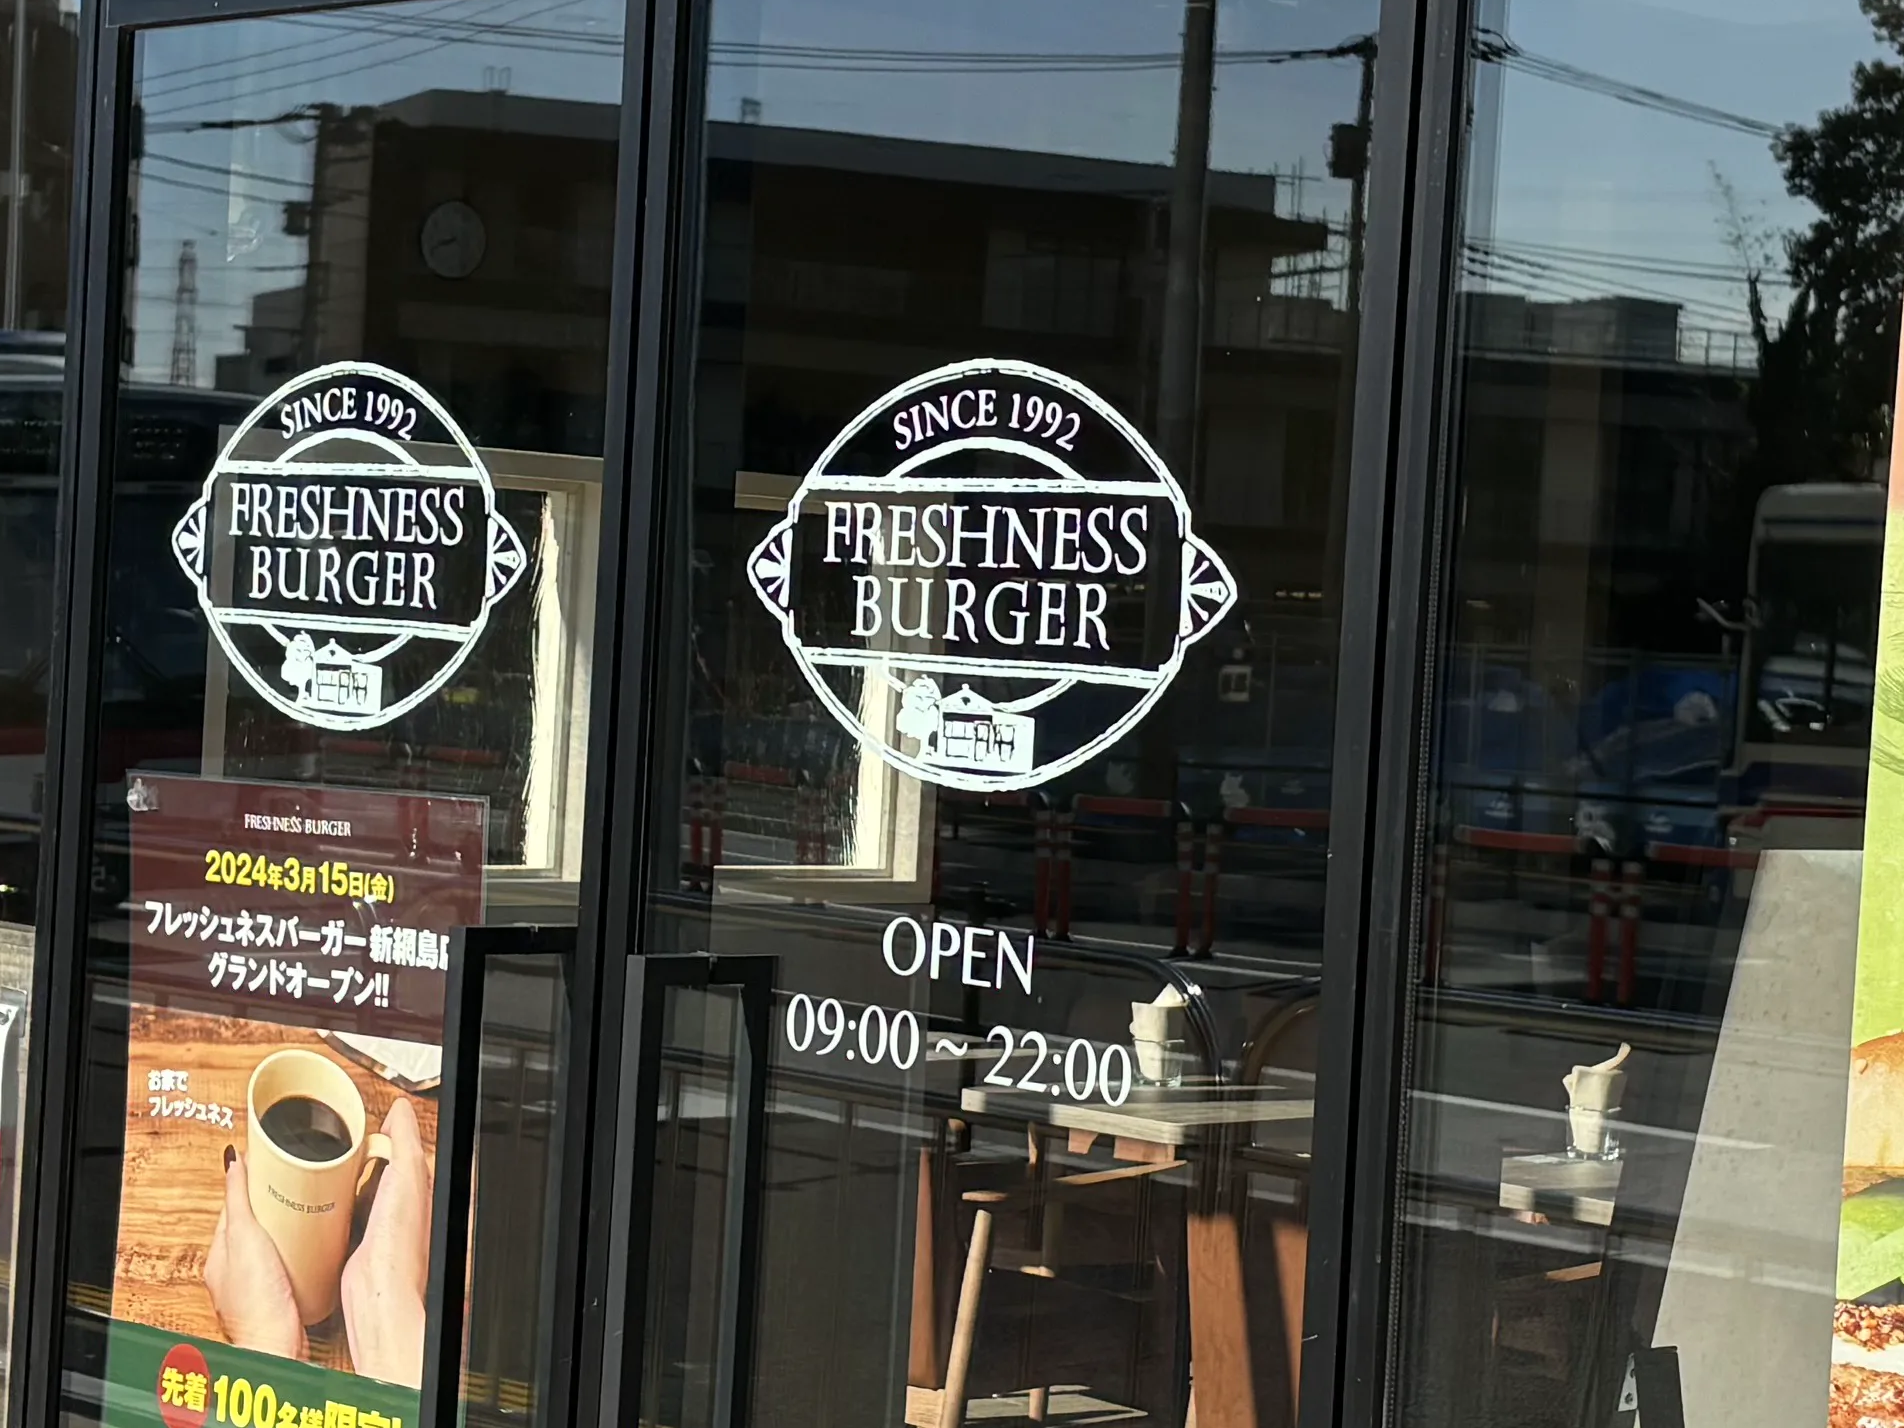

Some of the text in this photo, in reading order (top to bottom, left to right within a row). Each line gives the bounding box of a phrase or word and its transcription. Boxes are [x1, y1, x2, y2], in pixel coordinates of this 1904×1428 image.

[281, 387, 418, 441] SINCE 1992
[893, 389, 1082, 452] SINCE 1992
[228, 482, 465, 547] FRESHNESS
[823, 501, 1148, 576] FRESHNESS
[248, 546, 438, 610] BURGER
[851, 575, 1111, 651] BURGER
[244, 813, 352, 838] FRESHNESS BURGER
[205, 849, 394, 904] 2024年3月15日(金)
[882, 916, 1036, 995] OPEN
[785, 993, 920, 1071] 09:00
[983, 1024, 1132, 1108] 22:00
[148, 1097, 234, 1130] フレッシュネス
[161, 1366, 208, 1413] 先着
